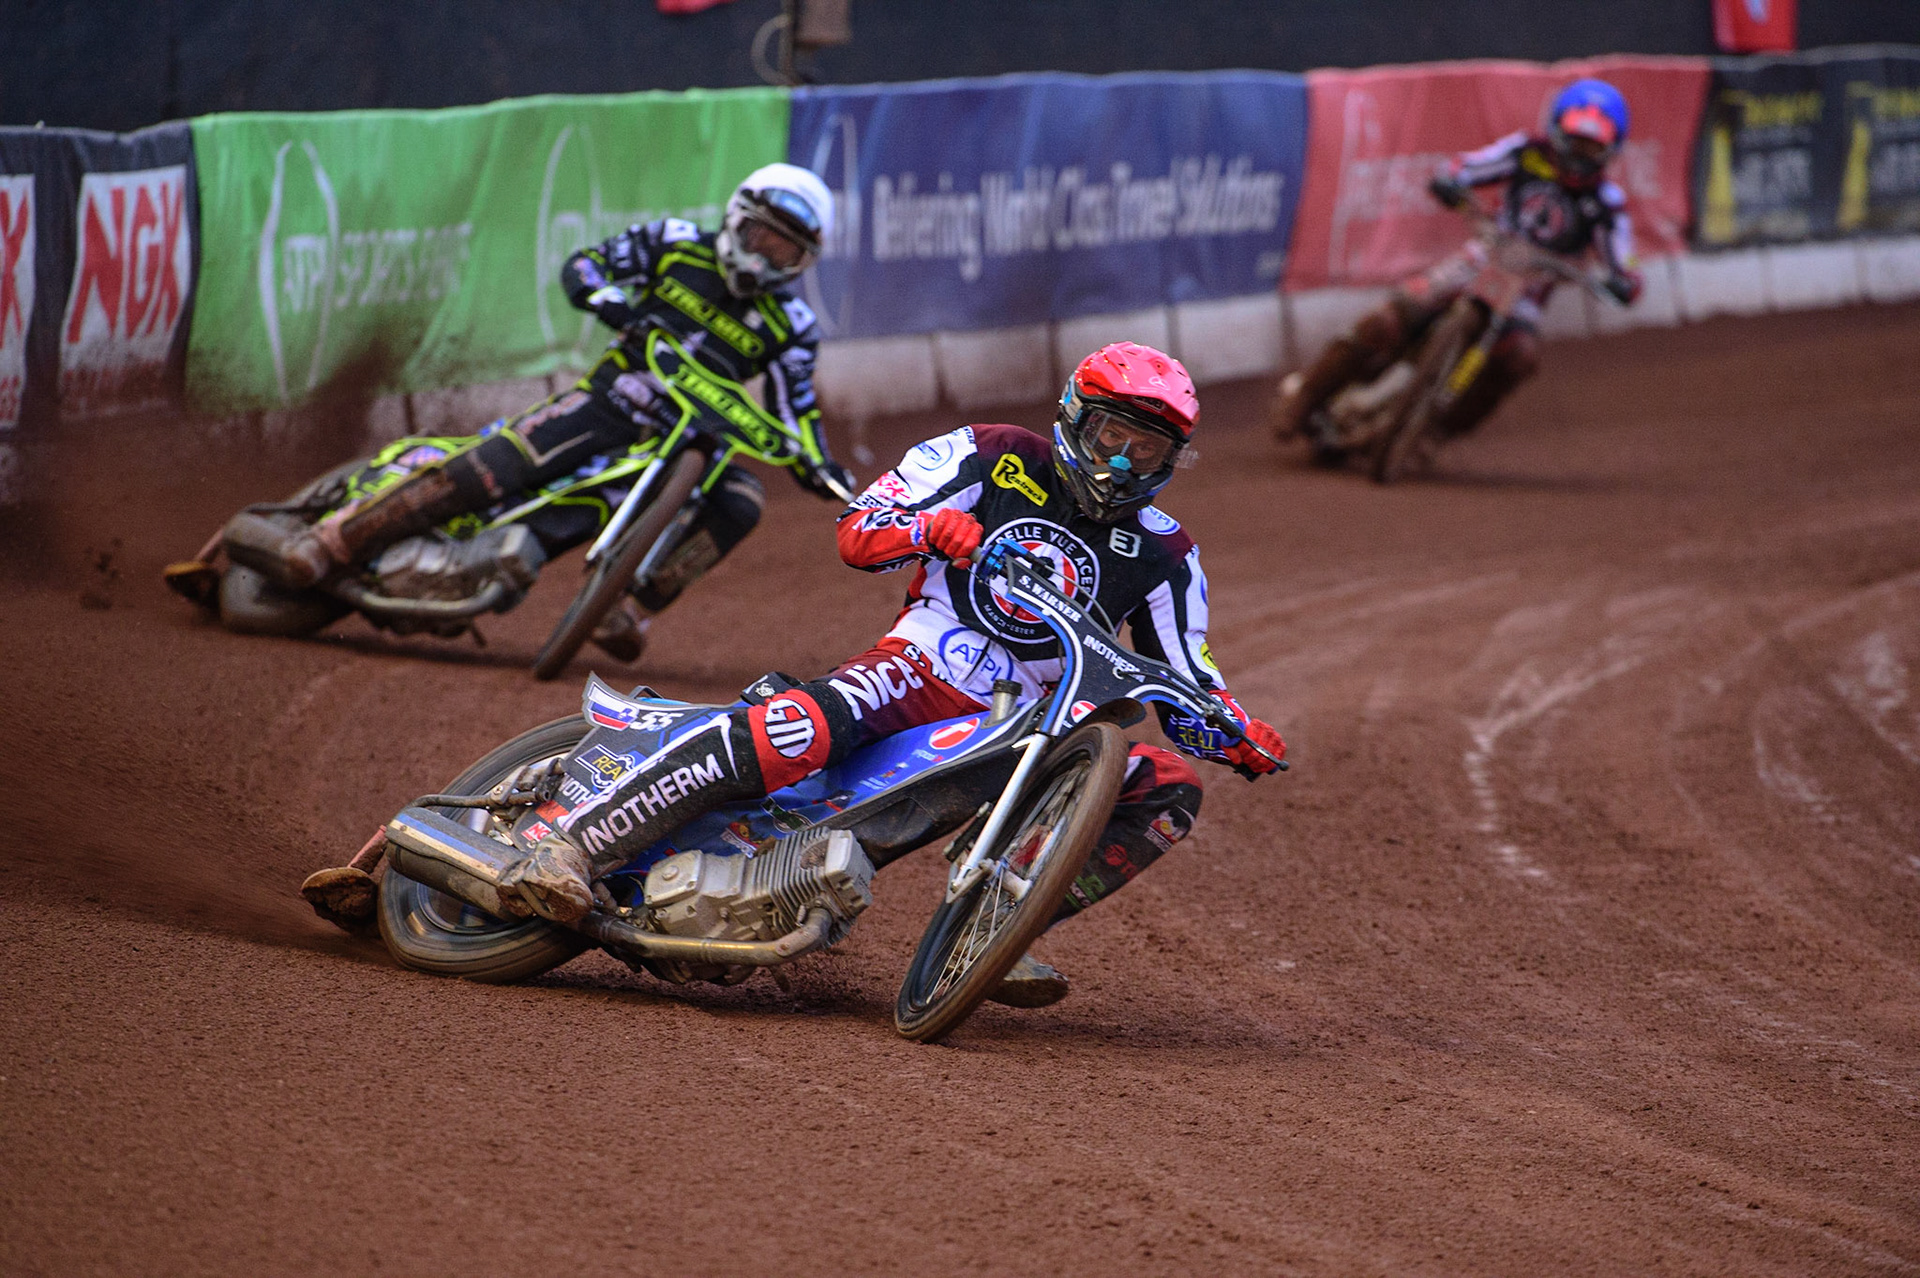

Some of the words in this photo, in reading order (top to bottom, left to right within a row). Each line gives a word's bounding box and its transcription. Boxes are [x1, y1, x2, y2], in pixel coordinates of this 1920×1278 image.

[66, 176, 184, 345] NGX
[1049, 530, 1078, 555] VUE
[1018, 575, 1031, 588] S.
[1031, 583, 1082, 623] WARNER
[558, 772, 597, 805] NOTH
[581, 753, 725, 856] INOTHERM
